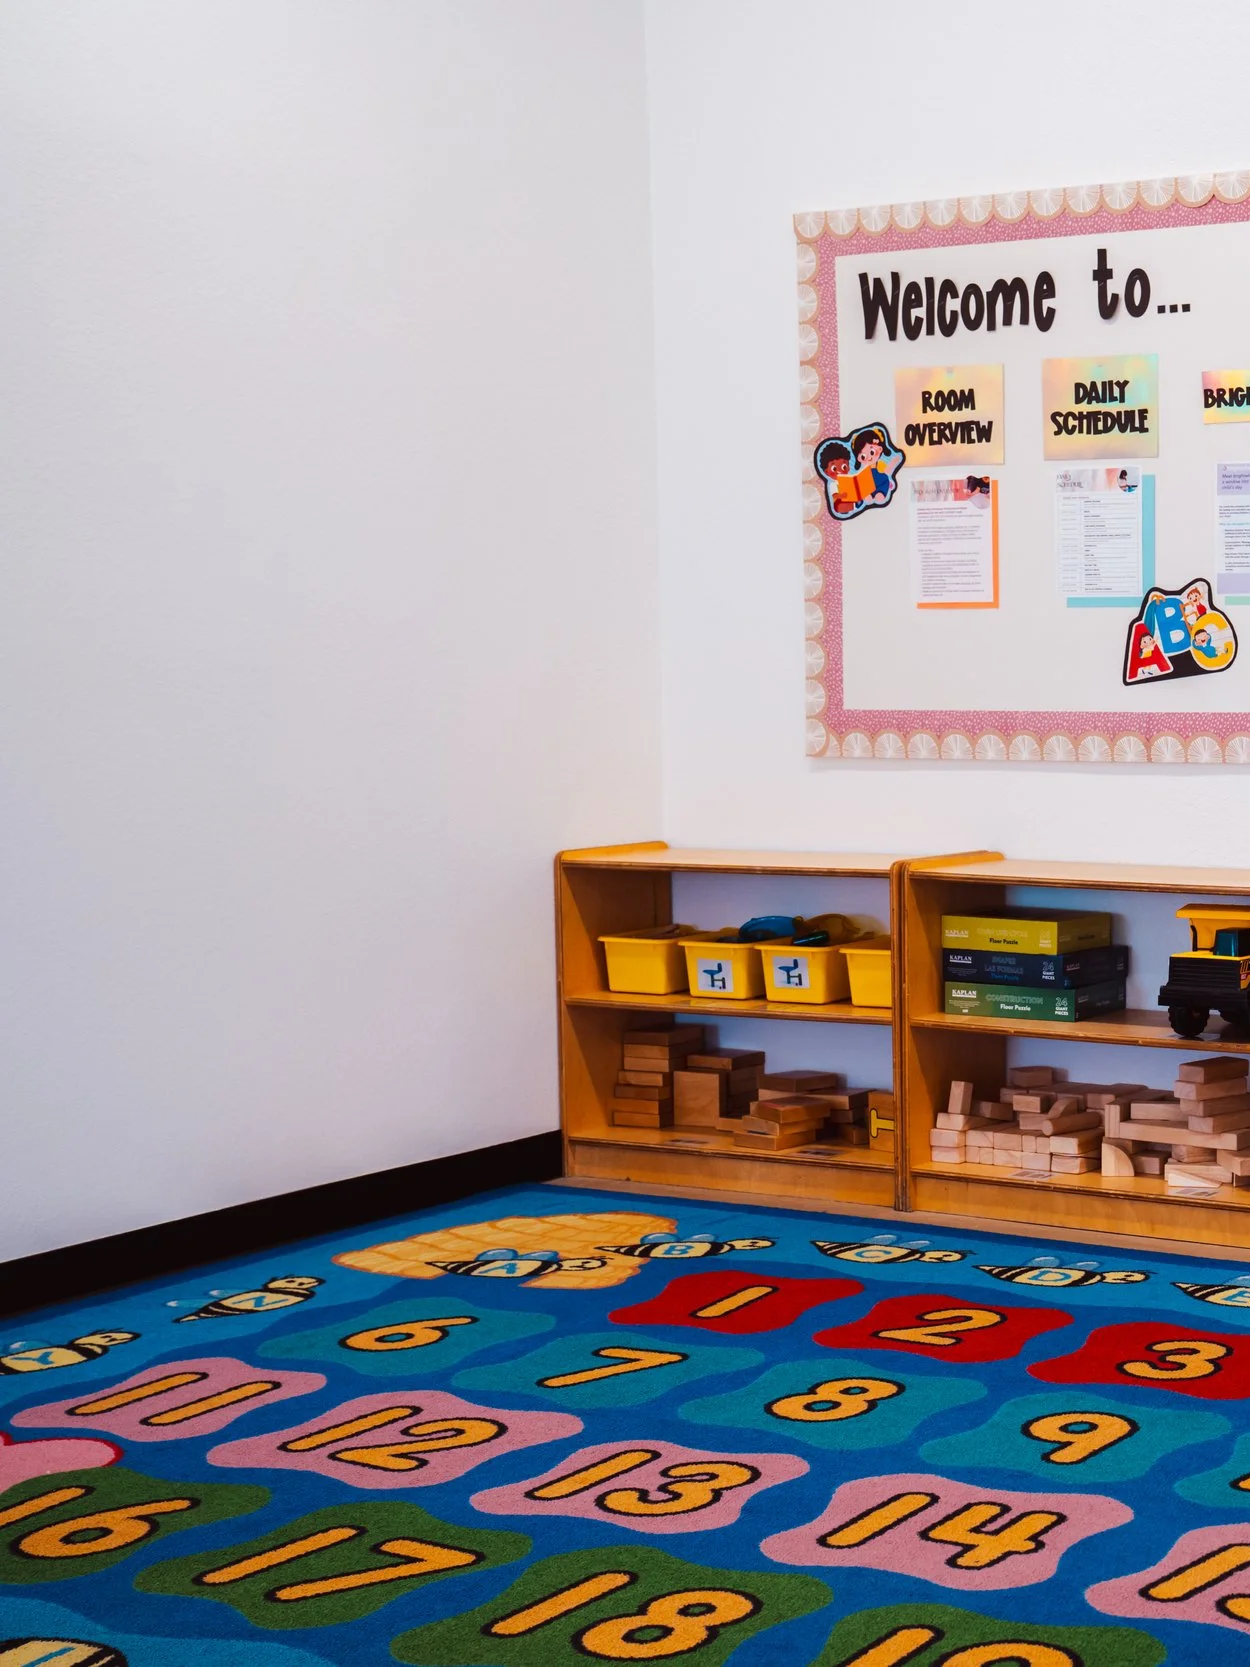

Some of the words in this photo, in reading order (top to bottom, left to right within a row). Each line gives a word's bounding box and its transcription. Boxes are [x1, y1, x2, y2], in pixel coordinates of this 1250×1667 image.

[859, 271, 1056, 342] Welcome
[1092, 248, 1191, 320] to...
[921, 388, 976, 414] ROOM
[1074, 379, 1130, 405] DAILY
[904, 420, 994, 447] OVERVIEW
[1050, 408, 1149, 436] SCHEDULE
[1127, 596, 1235, 681] ABC
[985, 994, 1044, 1005] CONSTRUCTION
[479, 1262, 521, 1275] A
[662, 1244, 693, 1256] B
[855, 1249, 892, 1260] C
[1027, 1268, 1073, 1283] D
[690, 1284, 780, 1319] 1
[340, 1315, 479, 1353] 6
[872, 1306, 1007, 1348] 2
[11, 1351, 55, 1366] Y
[536, 1346, 688, 1389] 7
[1116, 1337, 1233, 1383] 3
[68, 1370, 281, 1427] 11
[764, 1376, 906, 1423] 8
[280, 1404, 507, 1472] 12
[1021, 1409, 1140, 1465] 9
[528, 1449, 762, 1518] 13
[0, 1485, 200, 1560] 16
[817, 1490, 1068, 1571] 14
[194, 1524, 485, 1603] 17
[482, 1569, 763, 1661] 18
